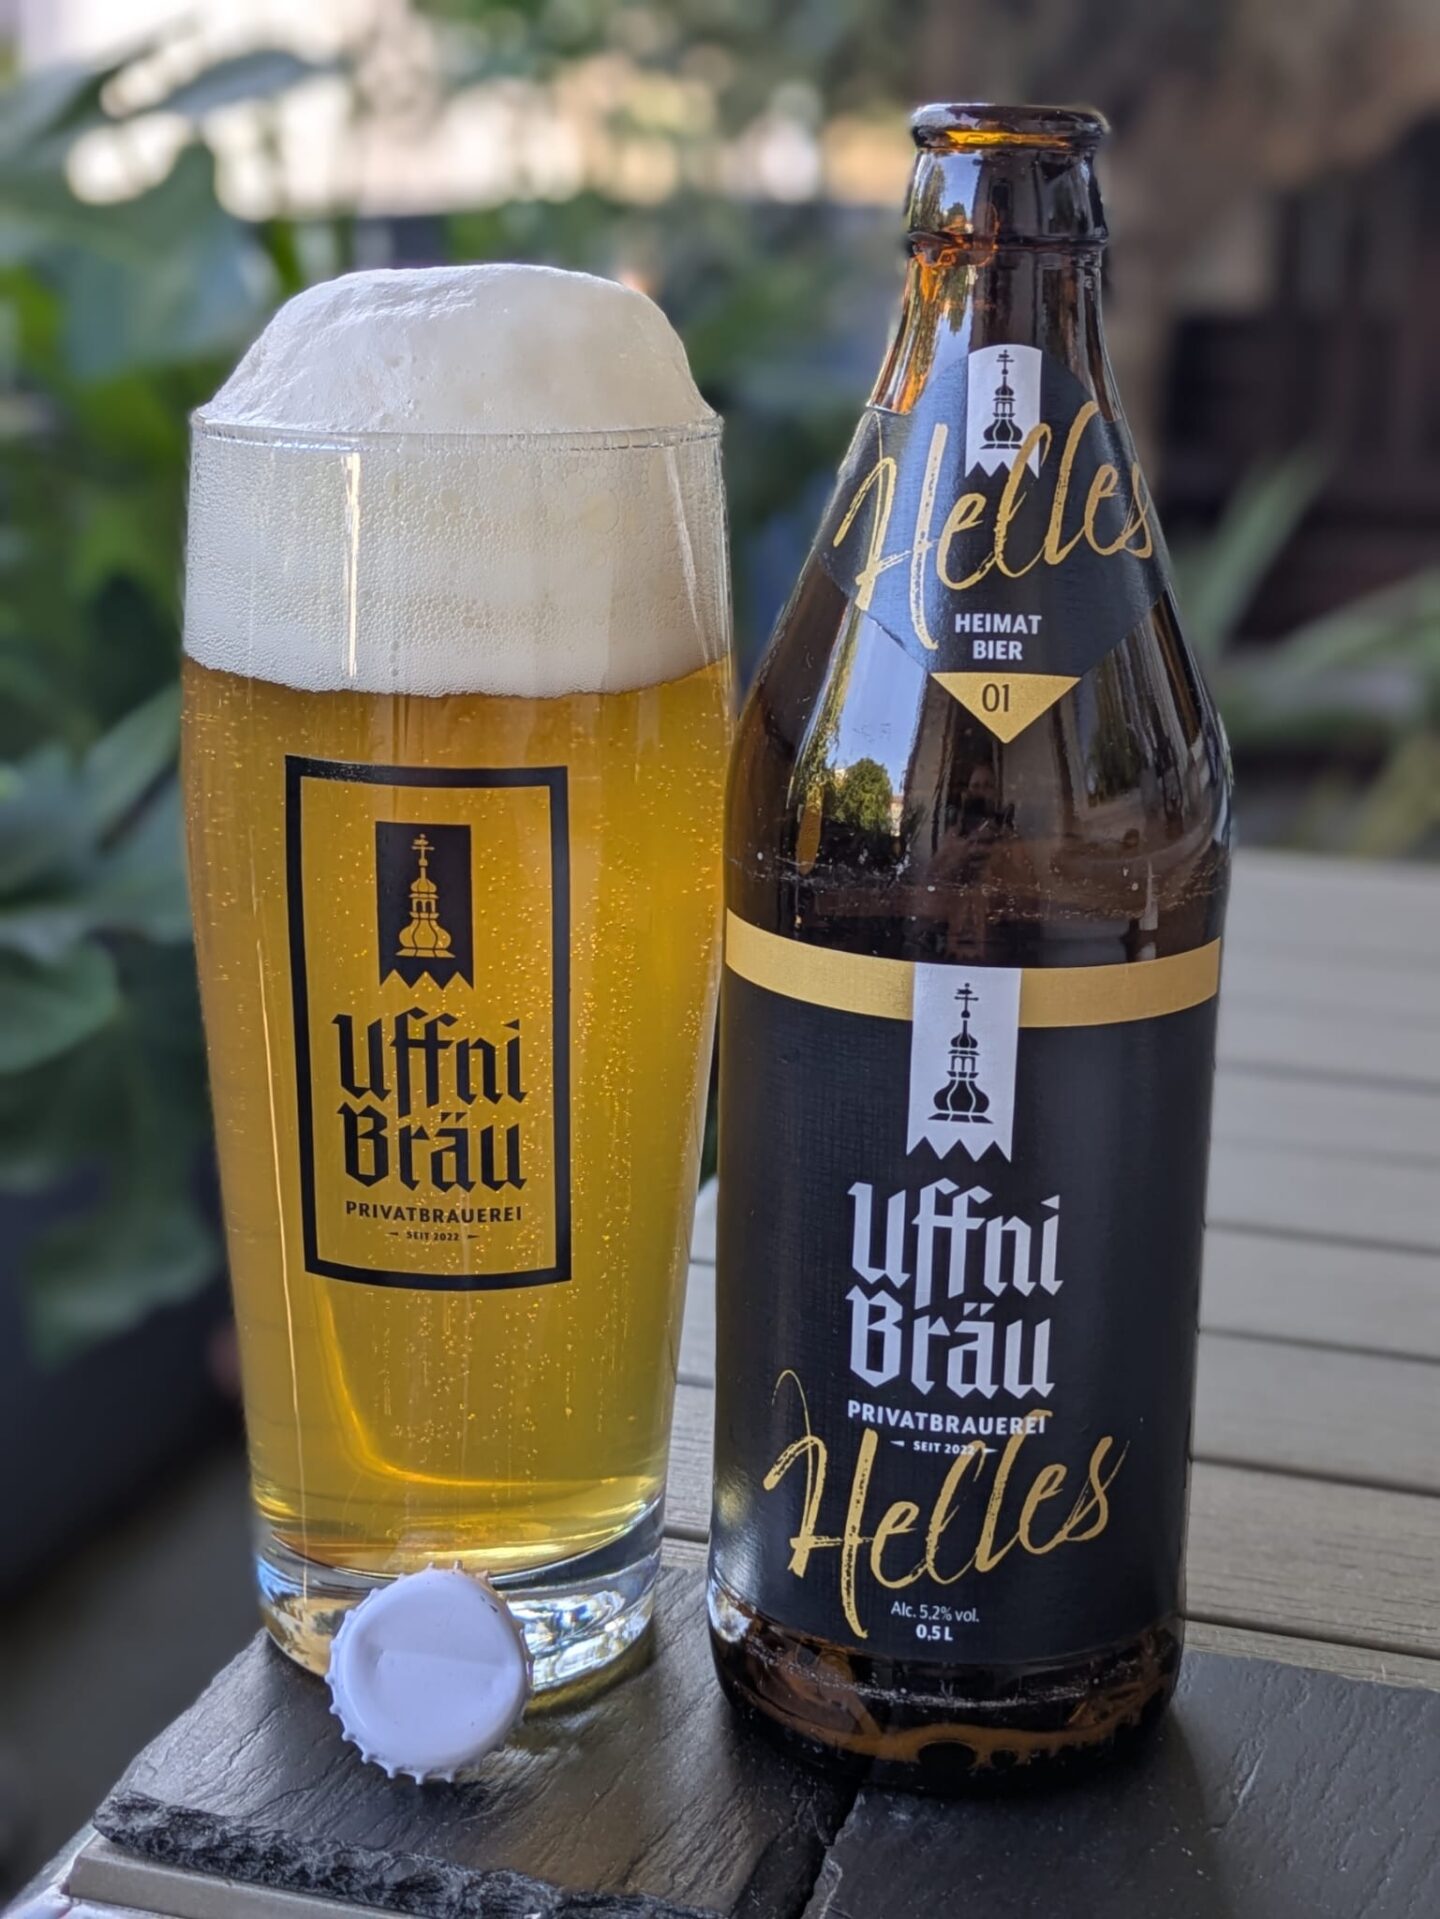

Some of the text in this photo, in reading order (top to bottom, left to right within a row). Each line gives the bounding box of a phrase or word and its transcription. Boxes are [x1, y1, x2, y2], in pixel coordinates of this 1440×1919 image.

[833, 400, 1153, 650] Helles
[955, 613, 1042, 634] HEIMAT
[973, 640, 1023, 660] BIER
[982, 683, 1009, 712] 01
[331, 1006, 528, 1119] Uffni
[337, 1102, 527, 1193] Bräu
[346, 1201, 522, 1223] PRIVATBRAUEREI
[406, 1231, 460, 1241] SEIT 2022
[847, 1177, 1064, 1309] Uffni
[845, 1288, 1056, 1399] Bräu
[848, 1399, 1046, 1435] PRIVATBRAUEREI
[913, 1440, 941, 1453] SEIT
[763, 1369, 1130, 1639] Helles
[891, 1601, 916, 1618] Alc.
[955, 1607, 979, 1622] vol.
[944, 1626, 953, 1641] L
